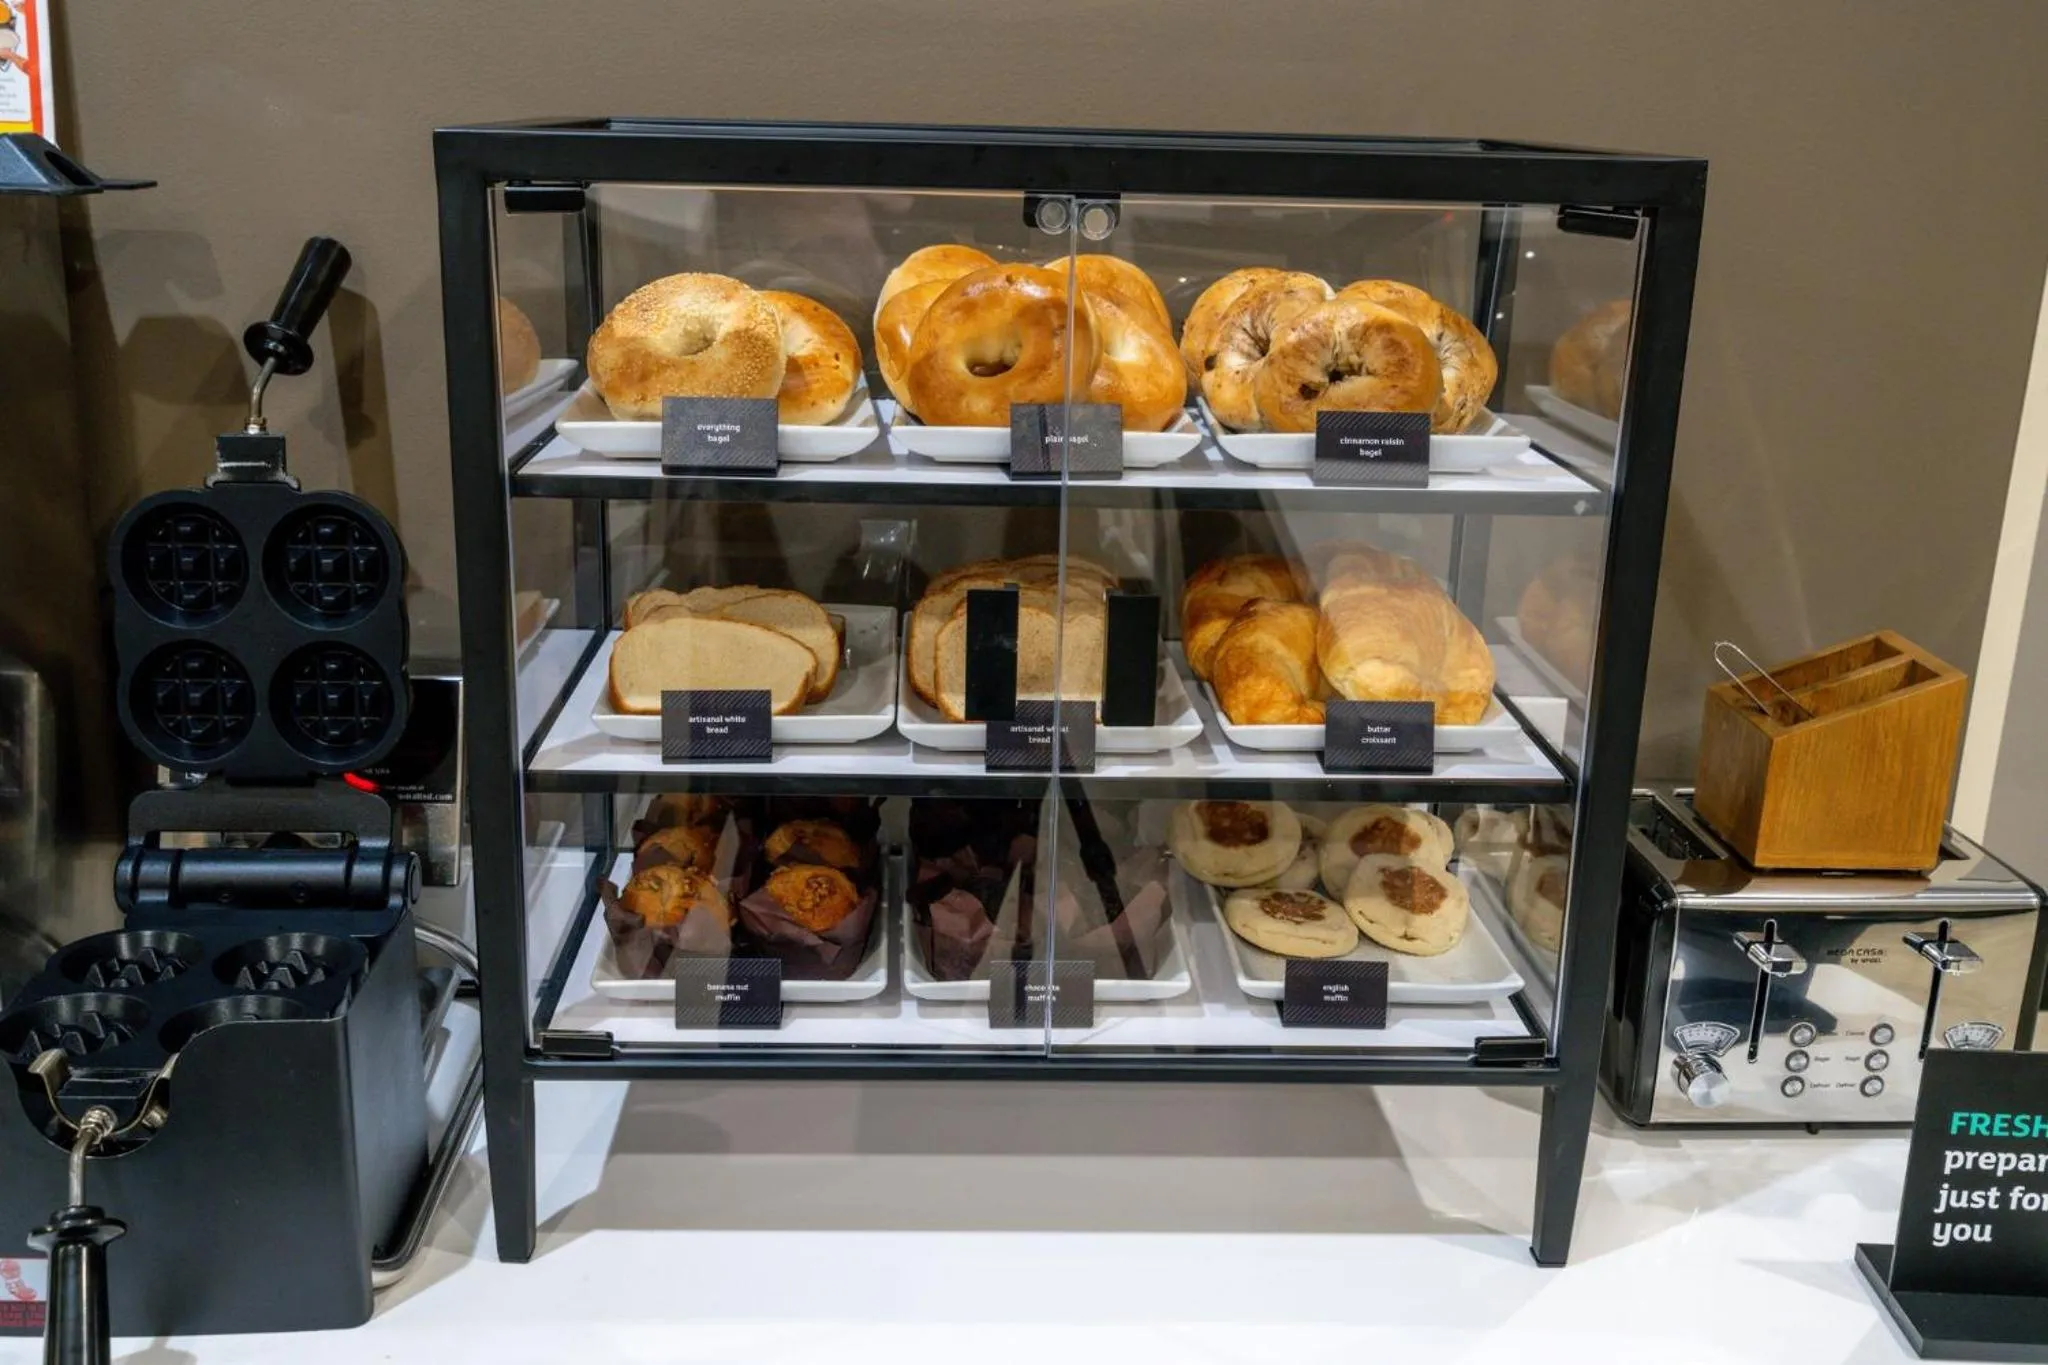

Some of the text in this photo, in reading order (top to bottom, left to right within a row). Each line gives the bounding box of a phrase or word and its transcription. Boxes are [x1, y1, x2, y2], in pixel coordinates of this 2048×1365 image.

[697, 423, 741, 433] everything
[707, 434, 730, 444] bagel
[1340, 435, 1405, 446] cinnamon raisin
[1359, 448, 1382, 458] bagel
[688, 715, 747, 723] artisanal white
[706, 726, 729, 734] bread
[1010, 725, 1044, 733] artisanal
[1367, 725, 1391, 733] butter
[1028, 736, 1051, 744] bread
[1360, 736, 1397, 744] croissant
[707, 983, 749, 991] banana nut
[1322, 984, 1350, 993] english
[715, 993, 741, 1002] muffin
[1323, 994, 1349, 1002] muffin
[1933, 1182, 2001, 1214] just
[1932, 1221, 1993, 1247] you
